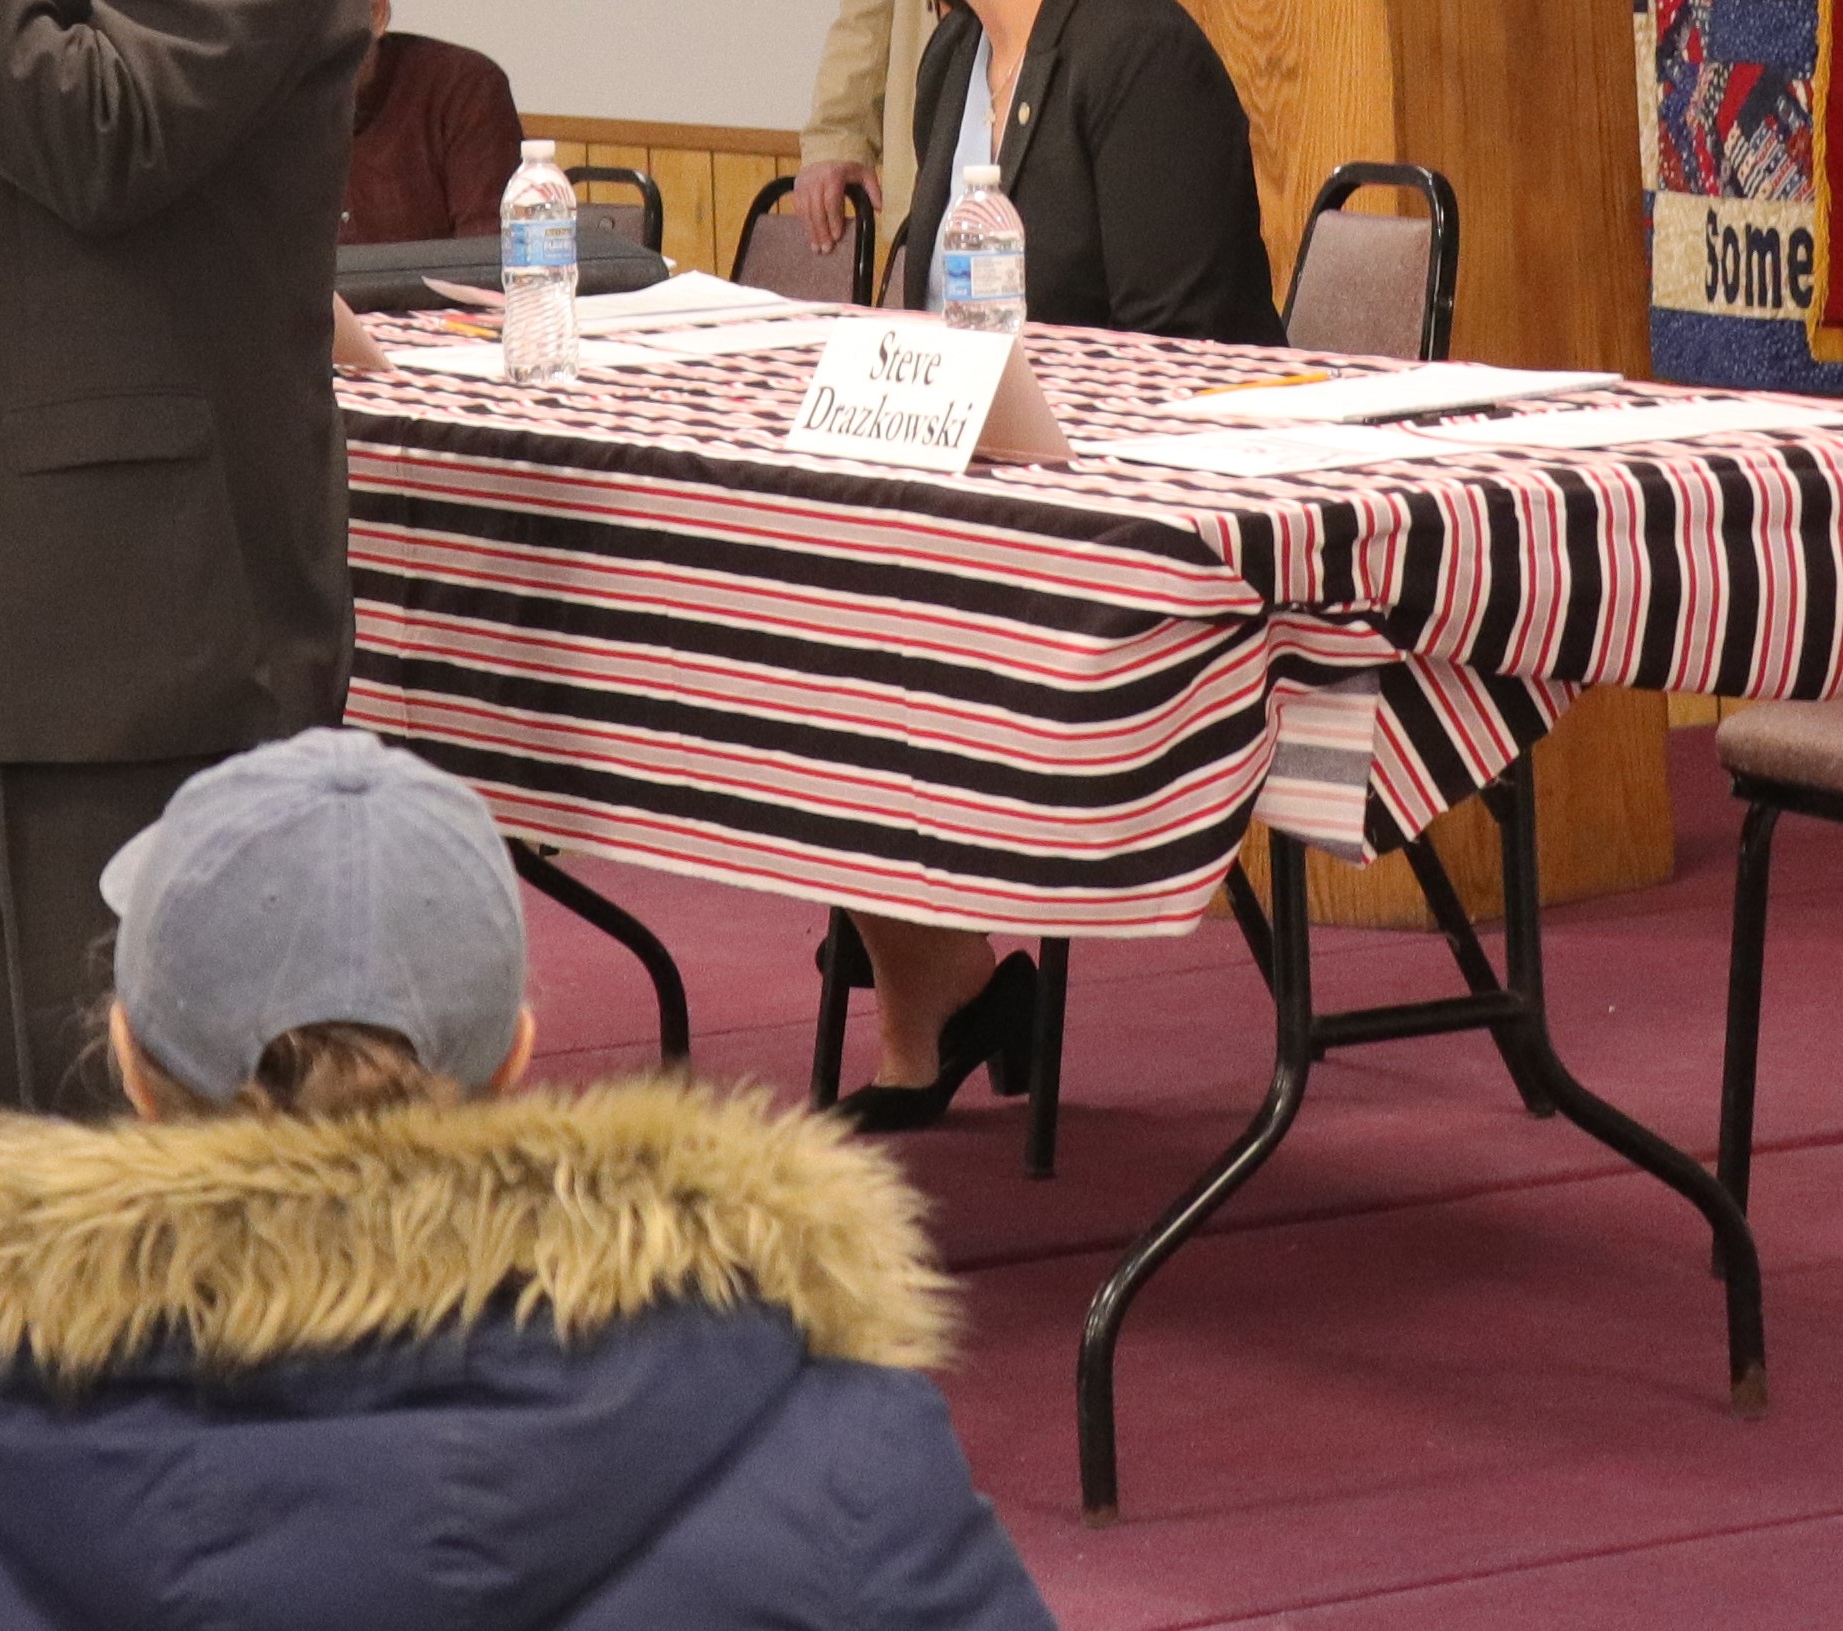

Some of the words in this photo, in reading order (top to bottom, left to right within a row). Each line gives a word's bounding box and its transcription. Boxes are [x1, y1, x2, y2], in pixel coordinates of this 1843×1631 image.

[1705, 206, 1816, 309] Some
[868, 329, 942, 386] Steve
[803, 385, 973, 449] Drazkowski
